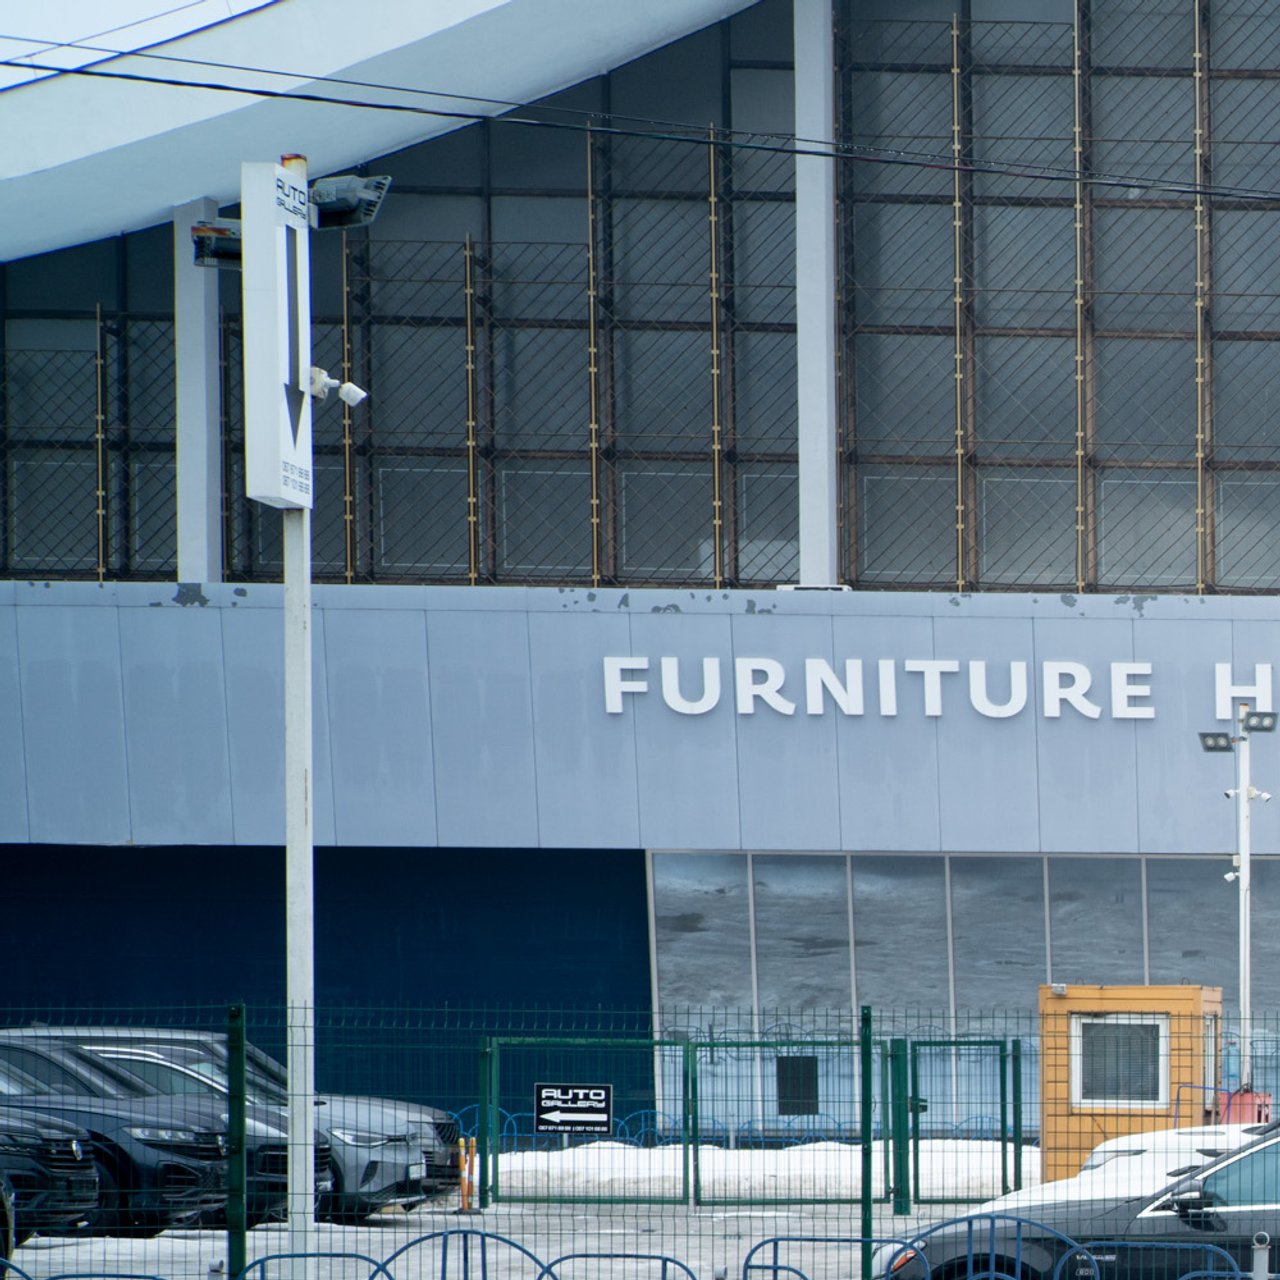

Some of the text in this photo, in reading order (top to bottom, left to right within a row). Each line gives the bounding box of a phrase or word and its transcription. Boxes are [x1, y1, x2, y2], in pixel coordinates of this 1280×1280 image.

[602, 655, 1157, 719] FURNITURE
[541, 1088, 606, 1100] AUTO
[541, 1100, 606, 1108] GALLERY
